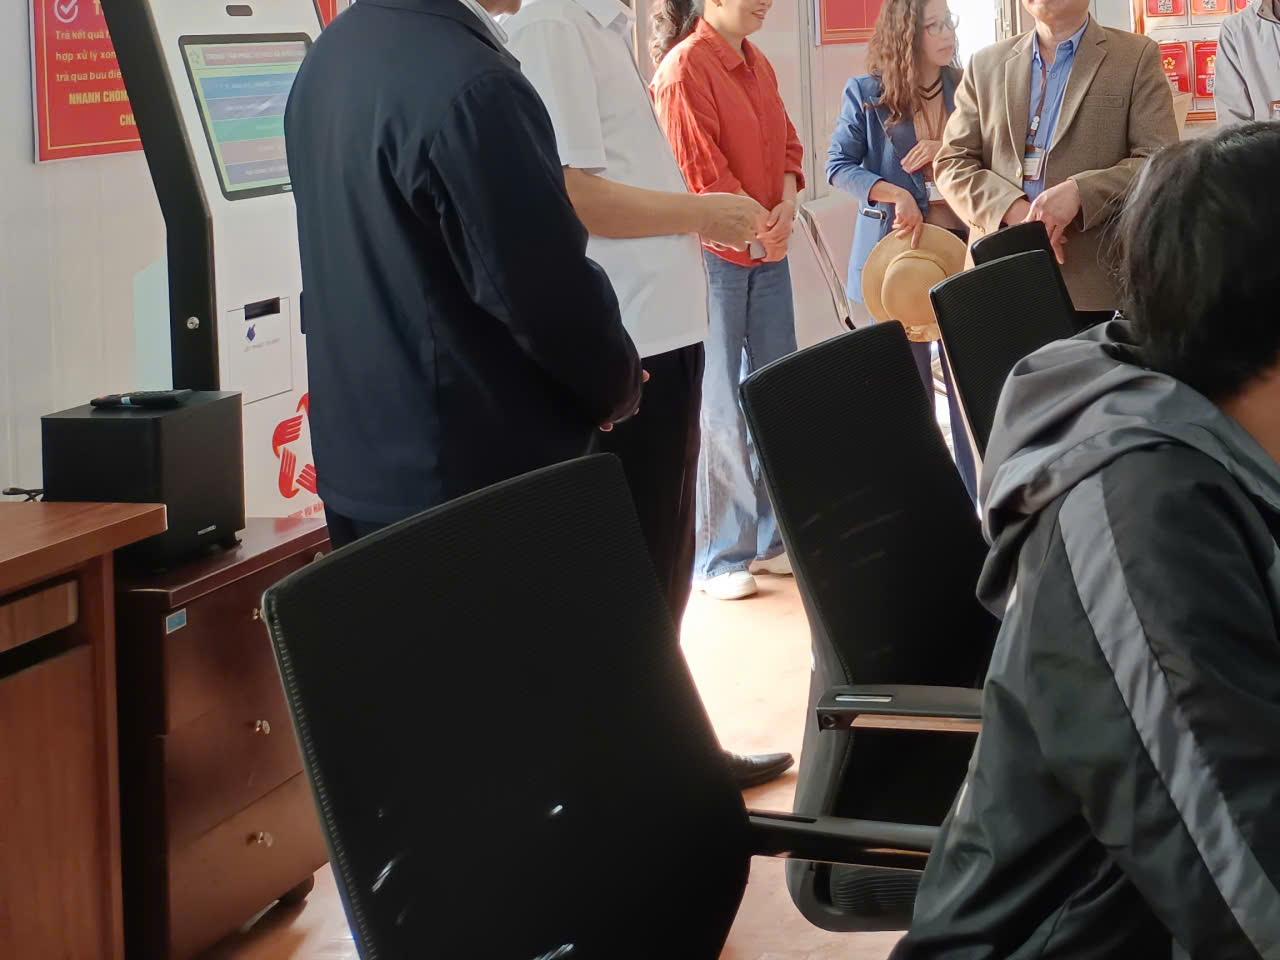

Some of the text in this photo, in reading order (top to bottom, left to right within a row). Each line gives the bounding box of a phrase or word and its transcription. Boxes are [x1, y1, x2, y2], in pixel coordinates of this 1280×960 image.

[100, 50, 117, 59] xon
[69, 89, 129, 105] NHANH CHÓN
